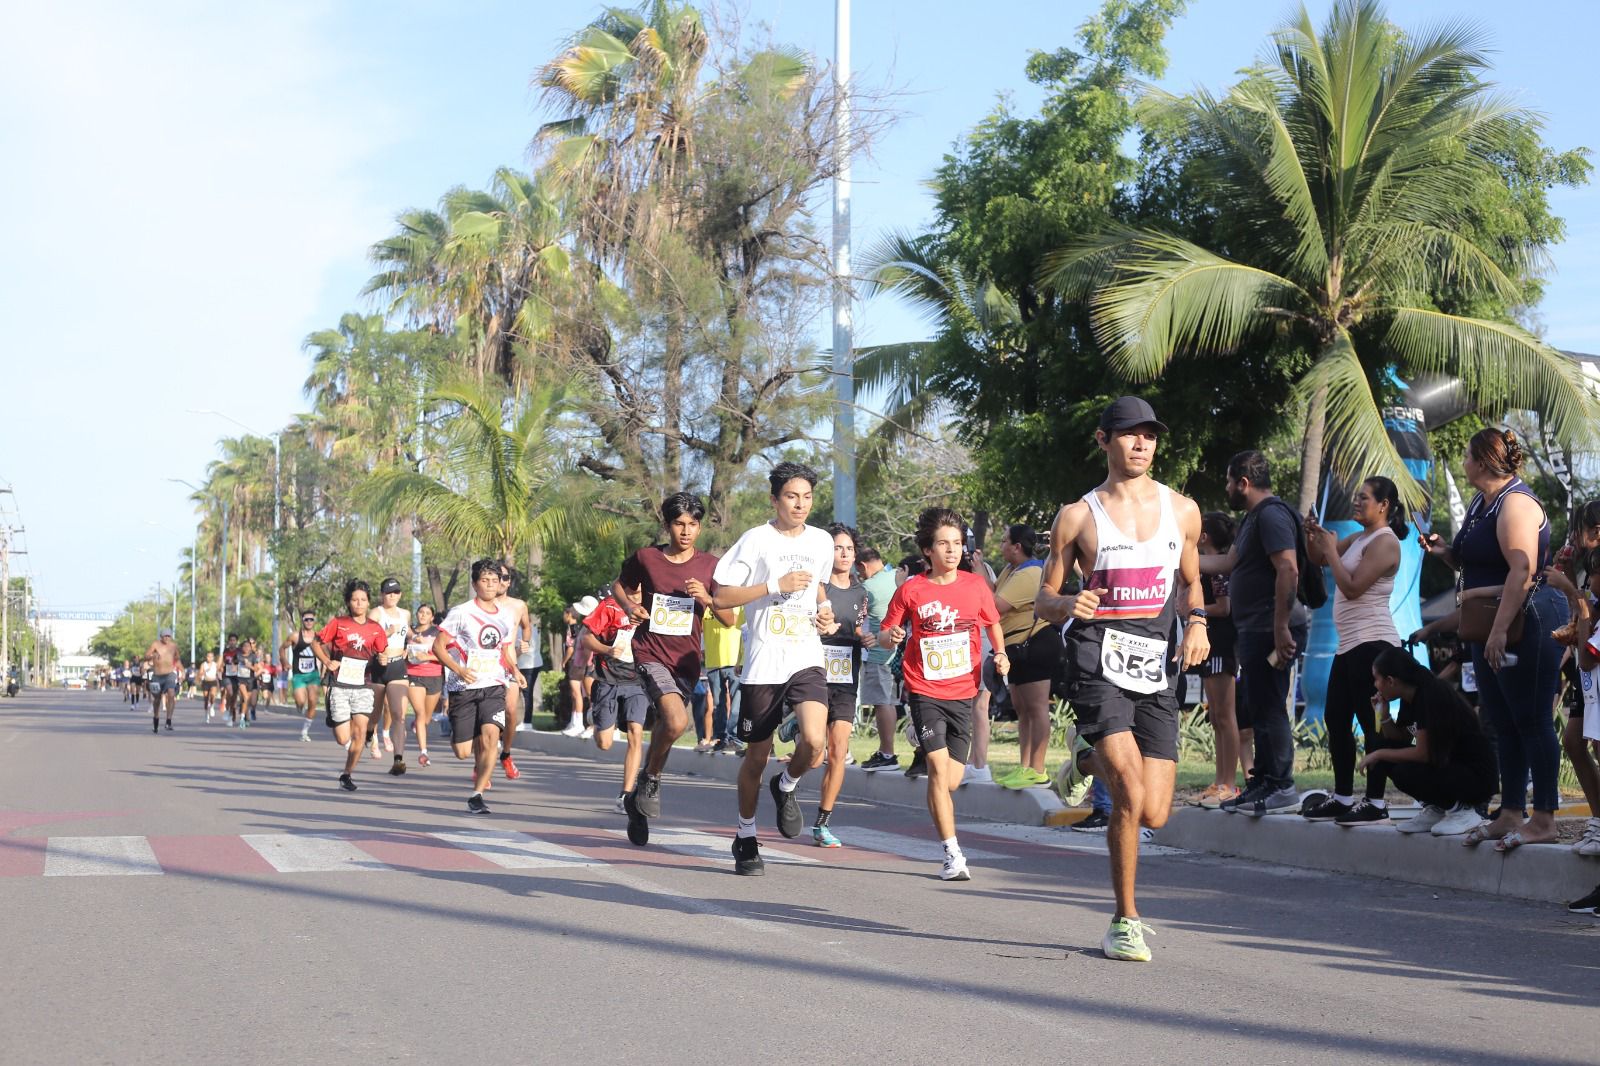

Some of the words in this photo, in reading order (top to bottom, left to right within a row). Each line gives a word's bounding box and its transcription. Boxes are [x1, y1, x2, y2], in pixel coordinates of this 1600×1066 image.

[1113, 584, 1165, 601] TRIMAZ
[654, 607, 690, 628] 022
[927, 647, 968, 671] 011
[1105, 650, 1162, 682] 059
